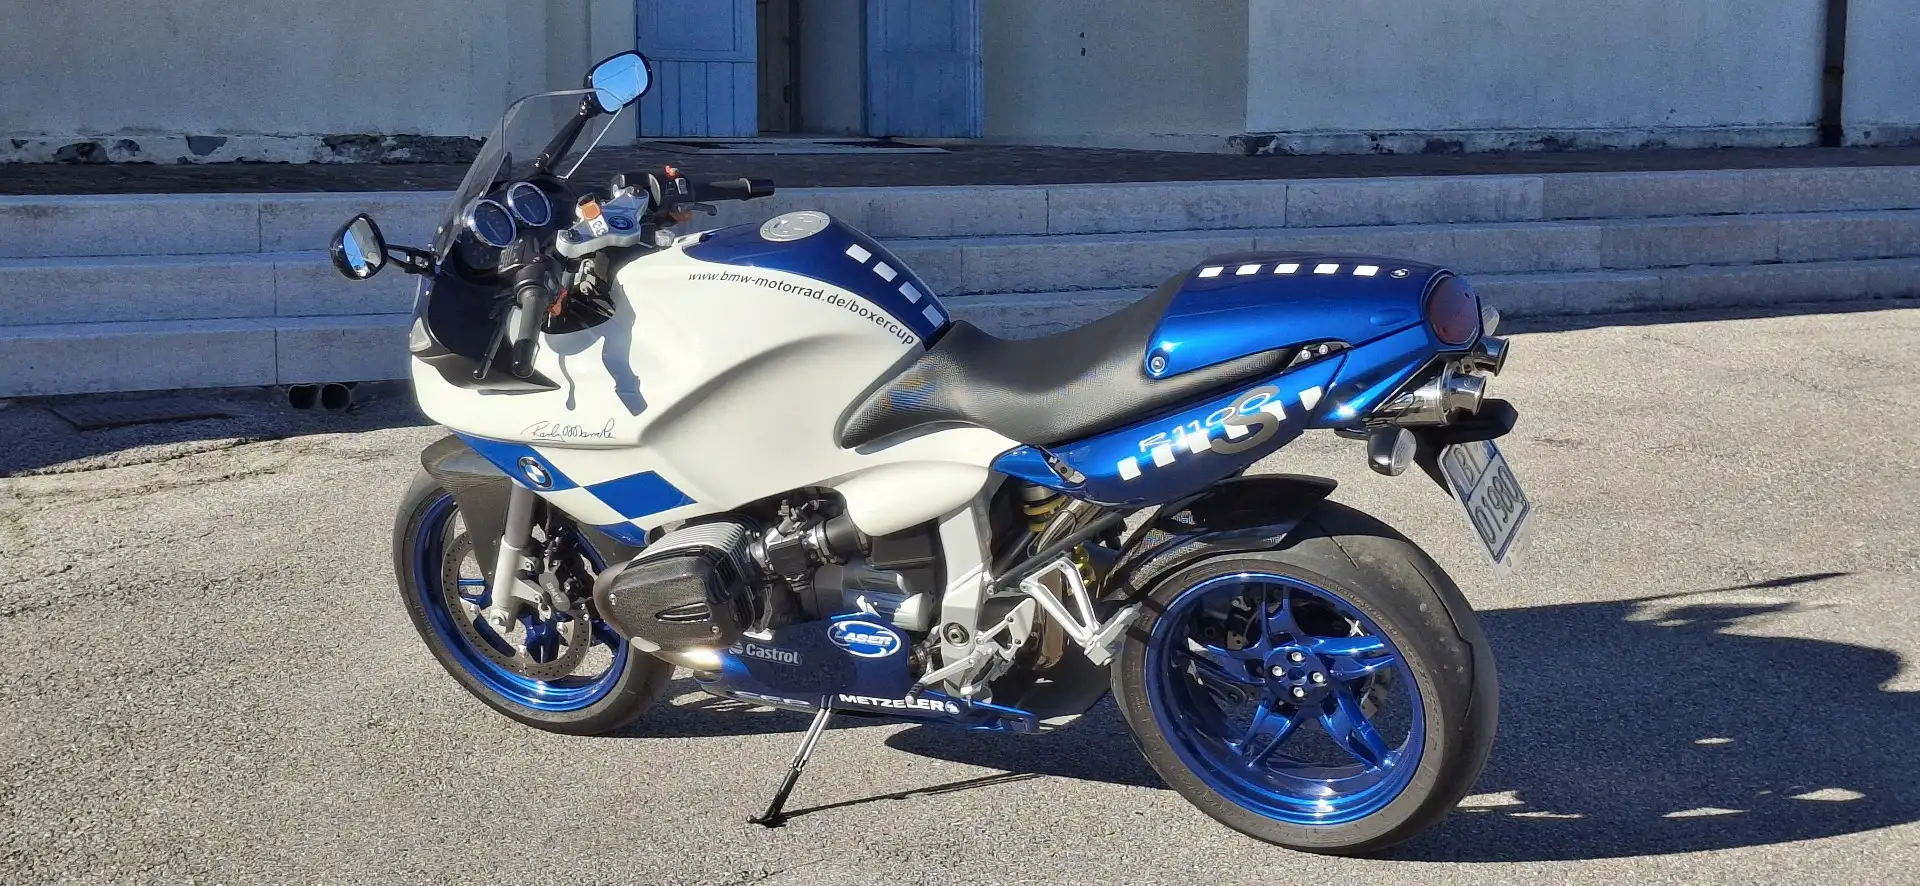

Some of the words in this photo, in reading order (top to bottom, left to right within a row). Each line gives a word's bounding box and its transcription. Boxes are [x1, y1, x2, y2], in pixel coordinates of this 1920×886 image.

[688, 271, 915, 346] www.bmw-motorrad.de/boxercup
[1475, 465, 1520, 545] 01980
[834, 630, 893, 647] LASER
[746, 643, 799, 665] Castrol
[838, 693, 945, 712] METZELER
